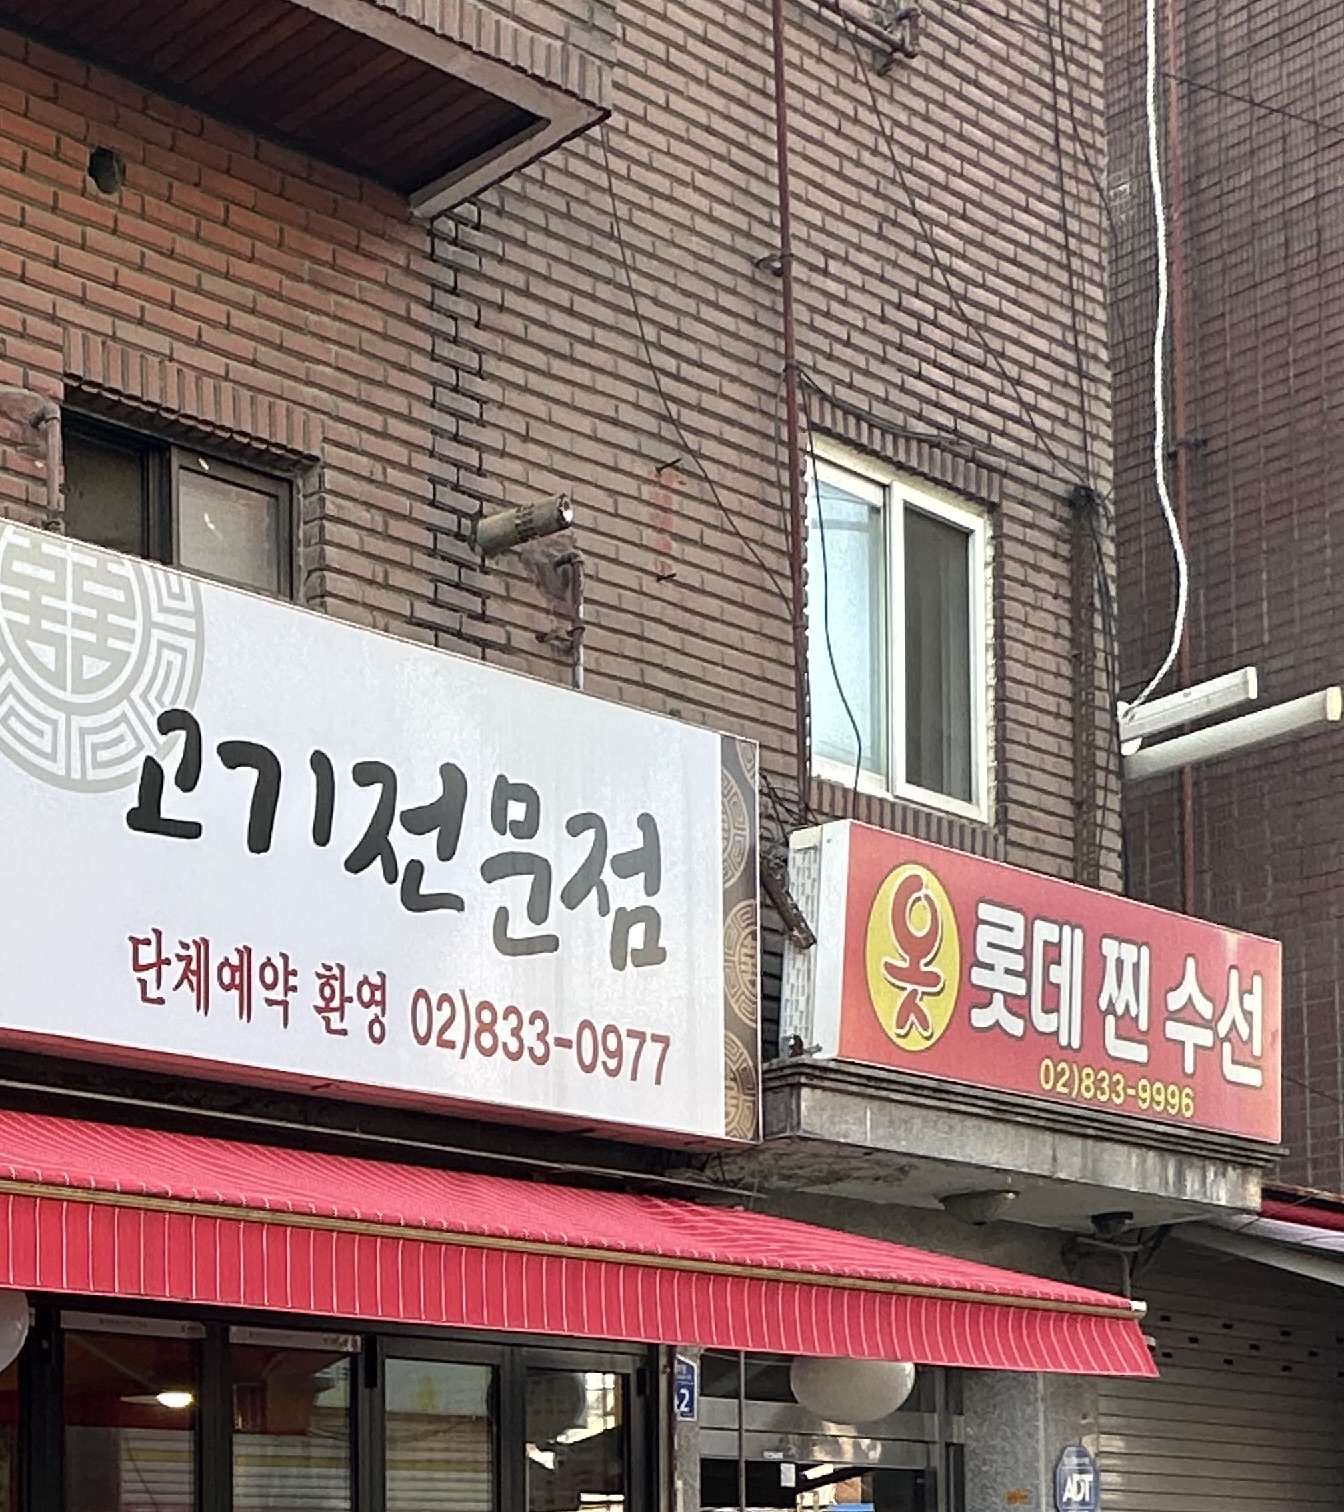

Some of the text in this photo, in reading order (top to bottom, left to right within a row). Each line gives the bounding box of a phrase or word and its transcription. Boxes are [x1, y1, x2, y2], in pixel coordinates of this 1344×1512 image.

[127, 709, 667, 970] 고기전문점
[128, 928, 672, 1087] 단체예약 환영 02)833-0977
[970, 900, 1264, 1089] 롯데 찐 수선
[1039, 1058, 1195, 1120] 02)833-9996
[1062, 1474, 1094, 1503] ADT
